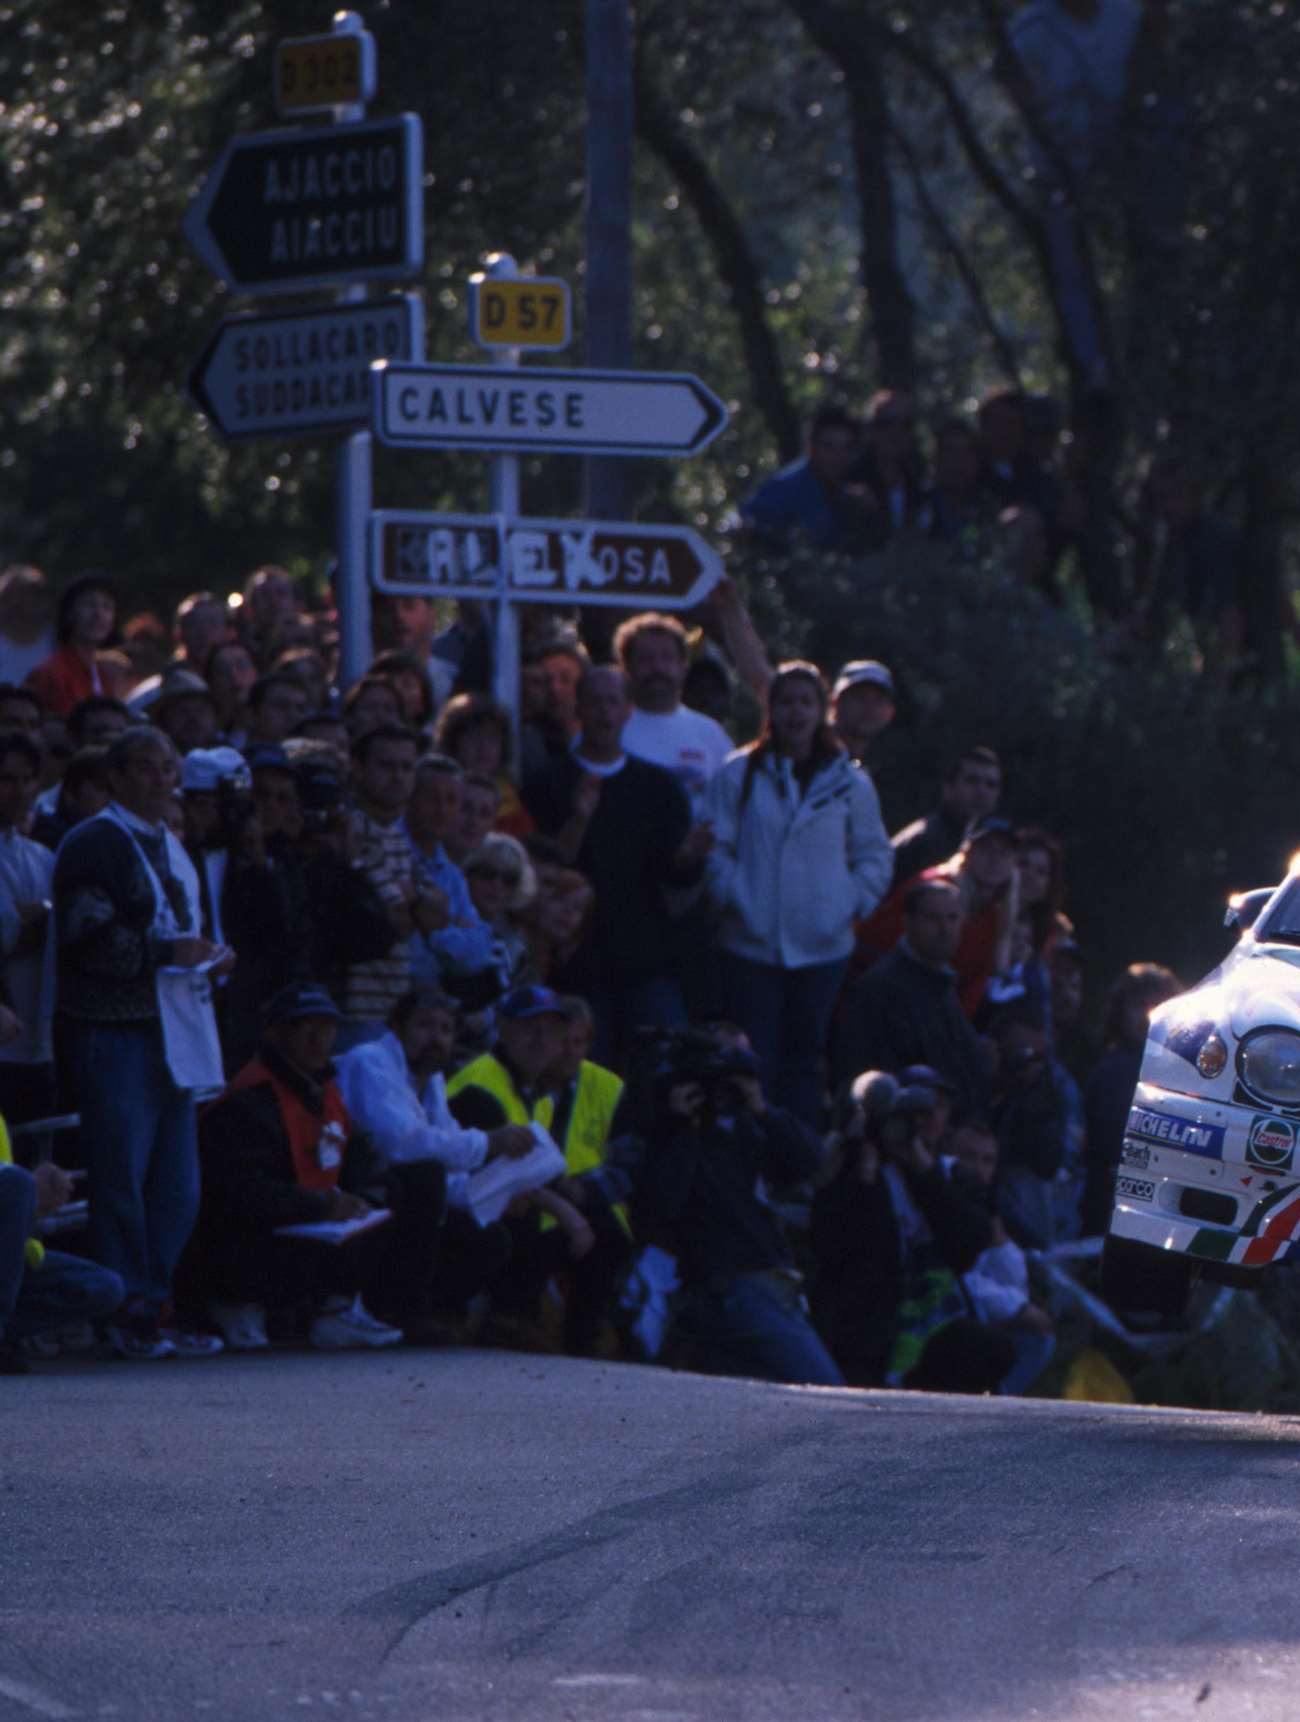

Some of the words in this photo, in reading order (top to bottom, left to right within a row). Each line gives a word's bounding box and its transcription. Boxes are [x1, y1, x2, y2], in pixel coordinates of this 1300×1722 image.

[262, 145, 397, 203] AJACCIO
[270, 206, 398, 264] AIACCIU
[485, 294, 506, 329] D
[518, 295, 562, 330] 57
[399, 388, 585, 429] CALVESE
[1256, 1131, 1293, 1150] Castrol
